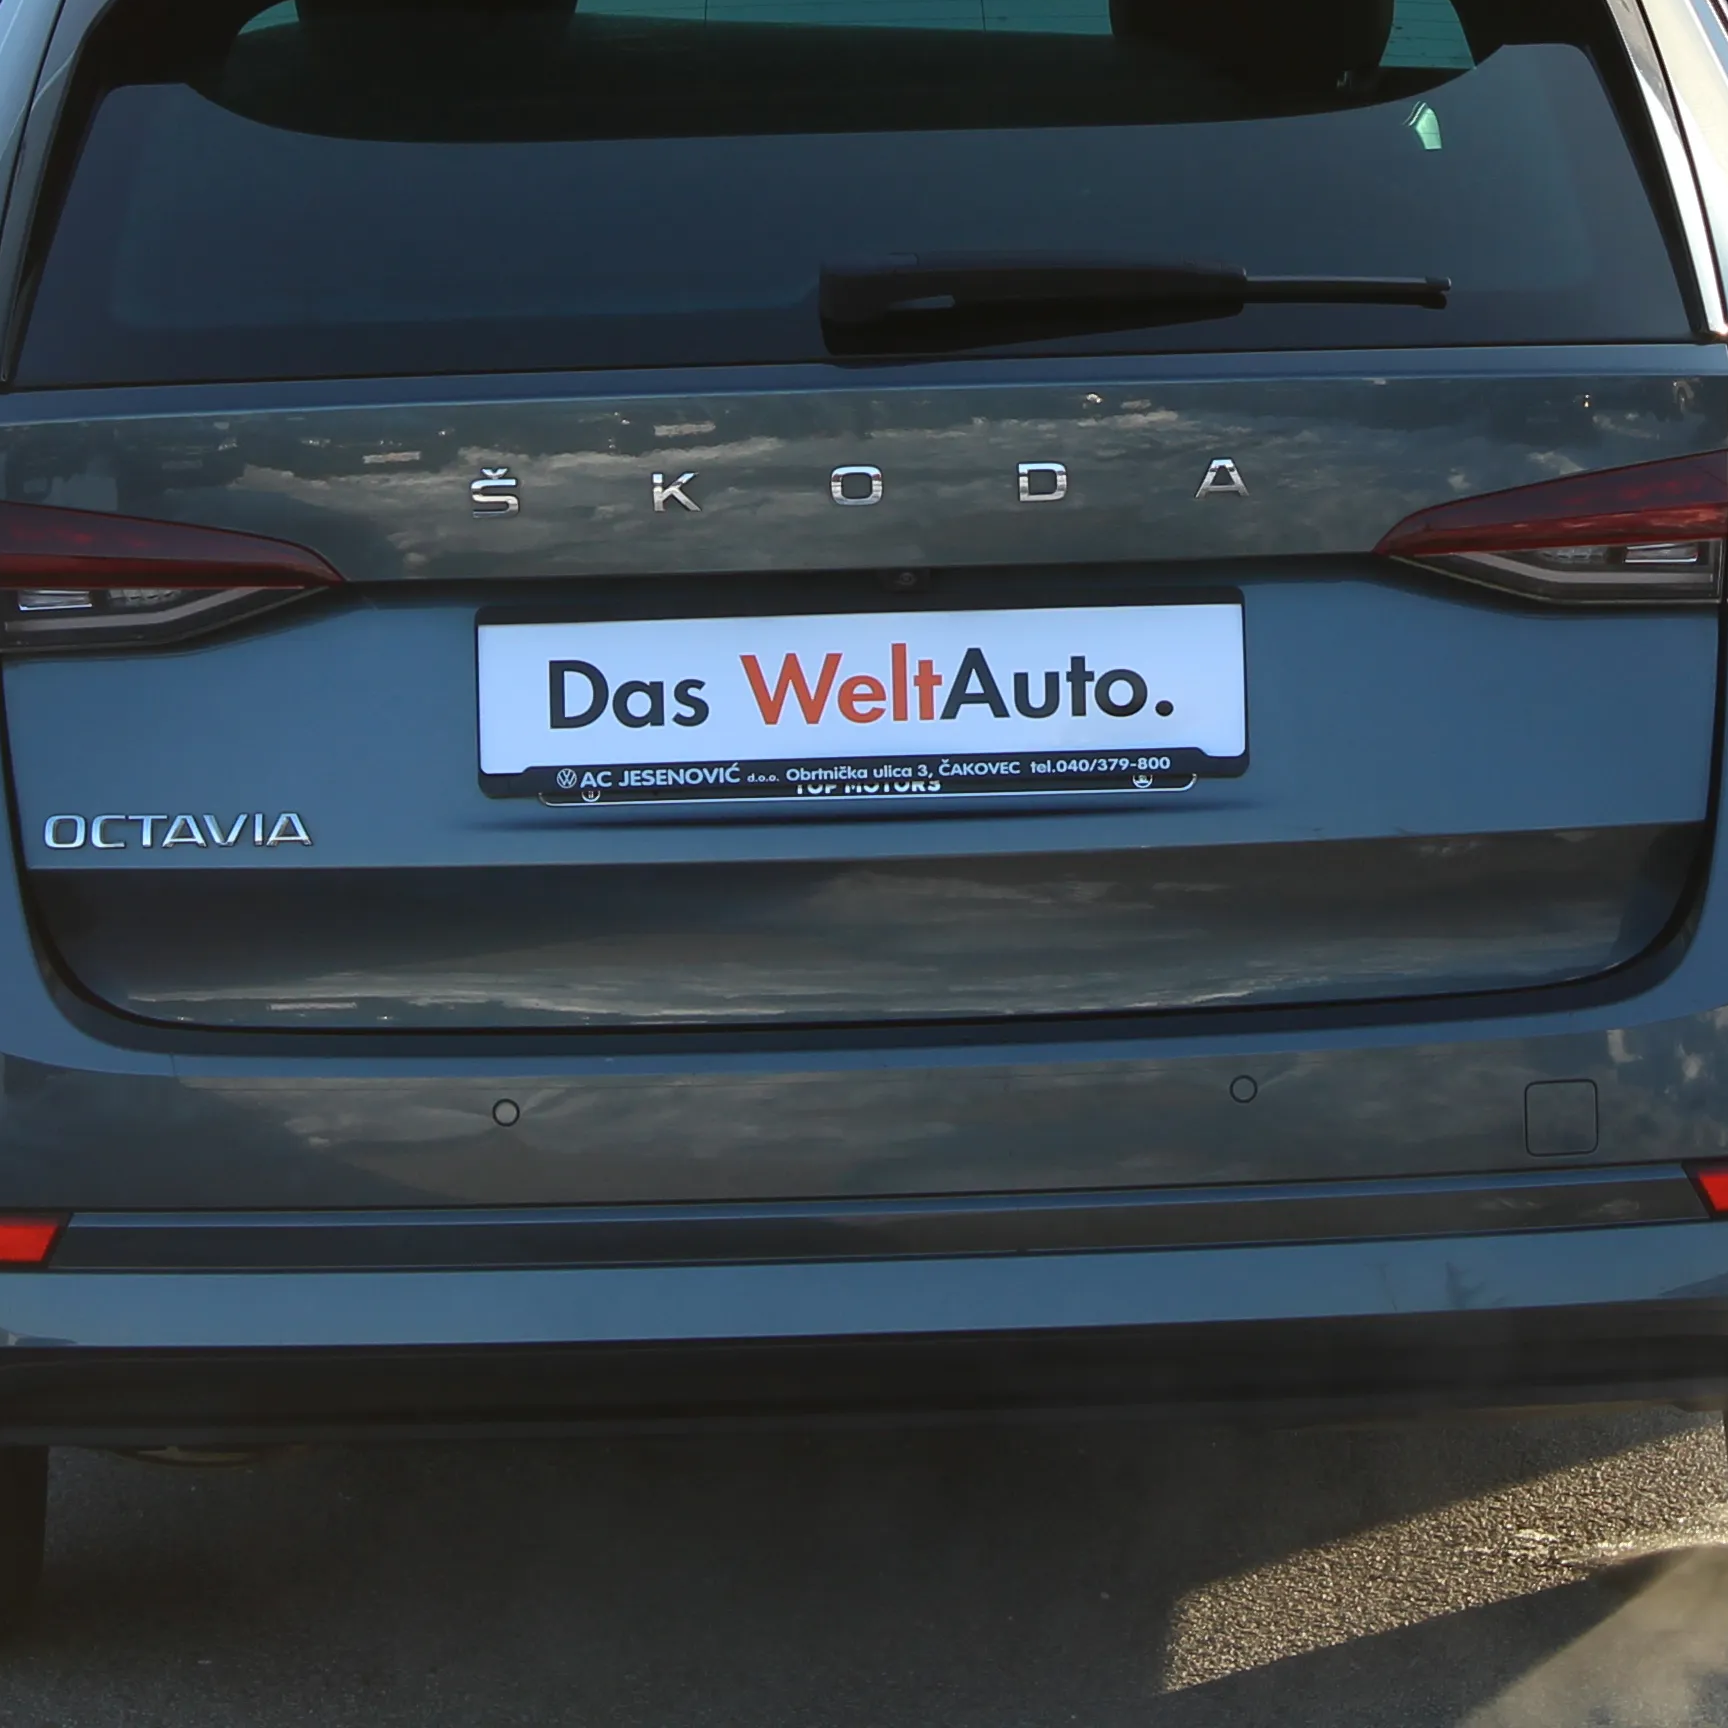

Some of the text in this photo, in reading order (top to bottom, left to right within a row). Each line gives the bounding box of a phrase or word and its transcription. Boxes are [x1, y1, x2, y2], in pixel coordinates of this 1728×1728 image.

[469, 457, 1251, 519] ŠKODA
[548, 642, 1175, 730] Das WeltAuto.
[580, 771, 612, 789] AC
[618, 762, 741, 788] JESENOVIĆ
[747, 773, 780, 783] d.o.o.
[785, 765, 869, 782] Obrtnička
[872, 764, 913, 779] ulica
[917, 764, 934, 779] 3,
[938, 758, 1021, 777] ČAKOVEC
[1030, 756, 1171, 775] tel.040/379-800
[43, 813, 314, 849] OCTAVIA
